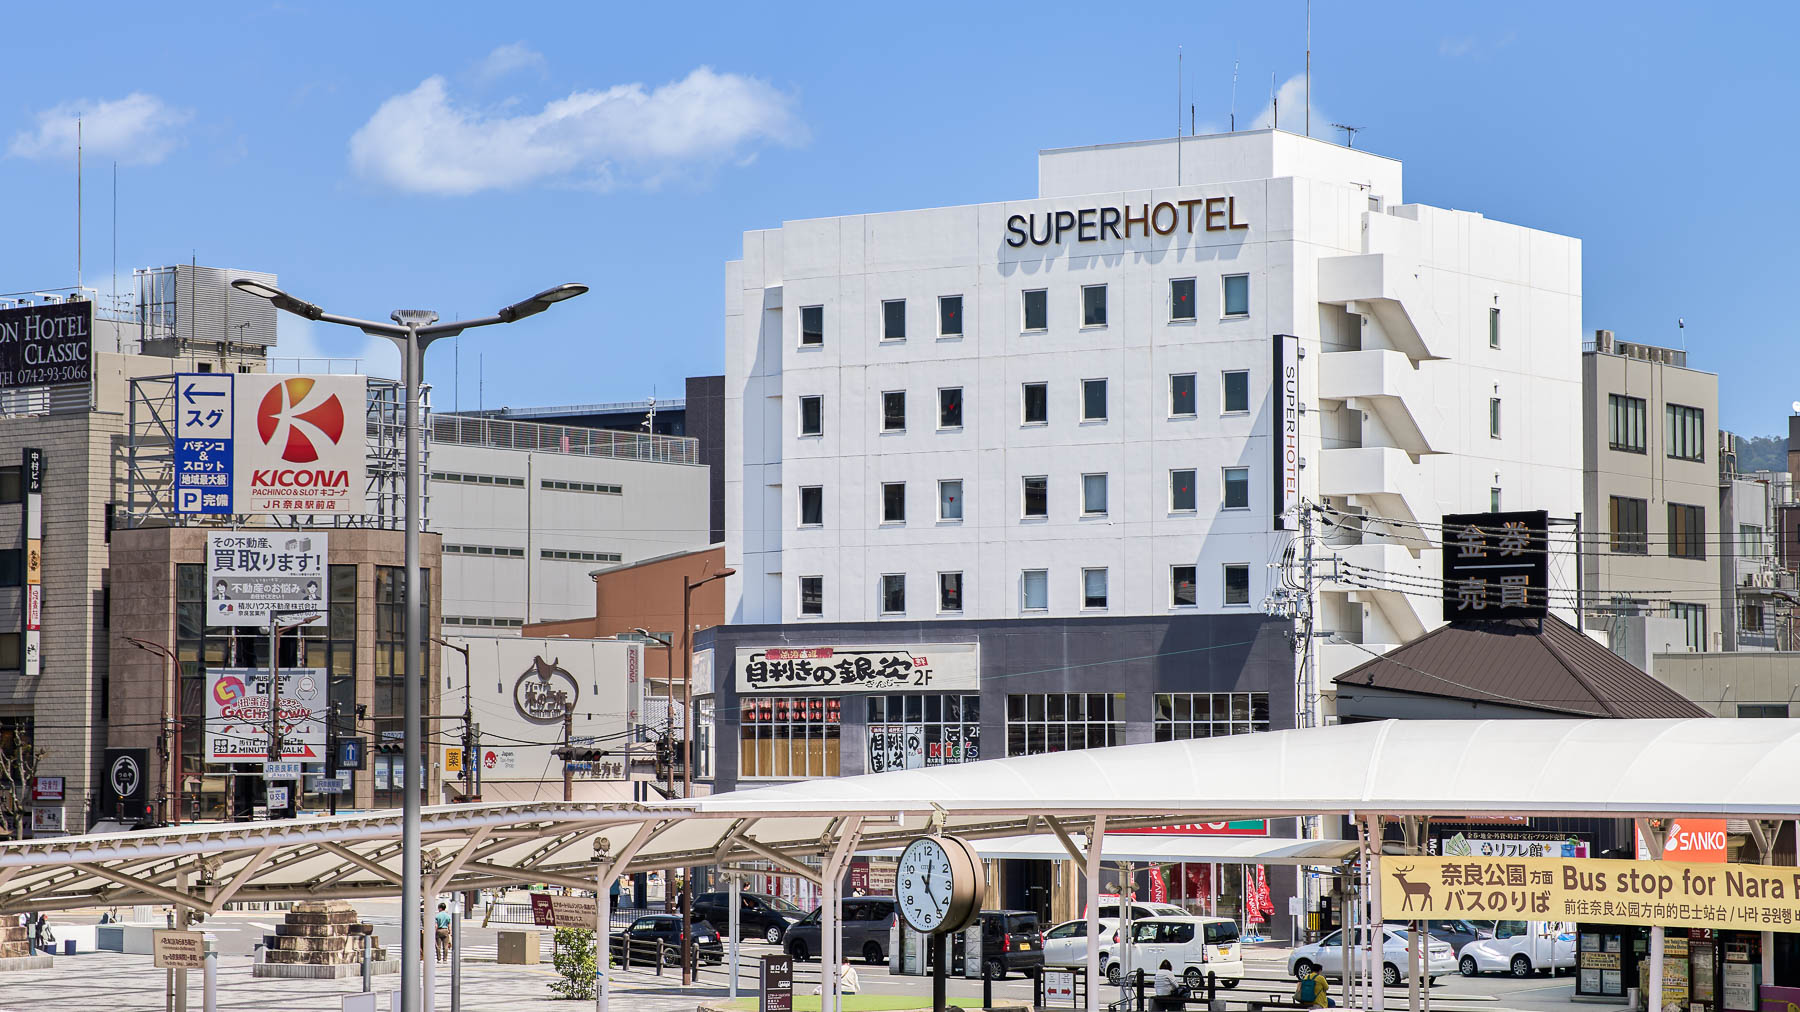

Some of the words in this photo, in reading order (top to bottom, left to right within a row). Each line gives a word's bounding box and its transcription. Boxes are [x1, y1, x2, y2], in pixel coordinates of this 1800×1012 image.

[24, 315, 87, 341] HOTEL
[25, 342, 87, 365] CLASSIC
[18, 365, 87, 384] 0742-93-5066
[186, 409, 224, 428] スグ
[183, 441, 225, 451] パチンコ
[199, 451, 209, 461] &
[31, 452, 39, 489] 中村ビル
[183, 461, 225, 471] スロット
[181, 474, 228, 485] 地域最大級
[251, 470, 349, 487] KICONA
[203, 494, 229, 507] 完備
[231, 583, 300, 594] 不動産のお悩み
[746, 657, 913, 685] 目利きの銀次
[914, 669, 933, 686] 2F
[230, 745, 237, 753] 2
[1680, 831, 1726, 851] SANKO
[924, 846, 932, 856] 12
[937, 850, 940, 860] 1
[1496, 842, 1544, 857] リフレ館
[914, 852, 920, 862] 11
[907, 865, 915, 874] 10
[942, 864, 949, 873] 2
[1441, 863, 1527, 887] 奈良公園
[1530, 871, 1553, 884] 方面
[905, 880, 911, 889] 9
[945, 881, 951, 890] 3
[1562, 865, 1607, 892] Bus
[1616, 868, 1673, 899] stop
[1683, 869, 1716, 896] for
[1725, 871, 1785, 899] Nara
[907, 896, 913, 905] 8
[942, 897, 949, 906] 4
[1444, 890, 1551, 913] バスのりば
[915, 909, 921, 918] 7
[936, 909, 942, 918] 5
[1564, 899, 1728, 922] 前往奈良公园方向的巴士站台
[1737, 906, 1759, 923] 나라
[1761, 908, 1792, 925] 공원행
[925, 914, 931, 923] 6
[1703, 928, 1711, 938] 2
[781, 961, 789, 973] 4
